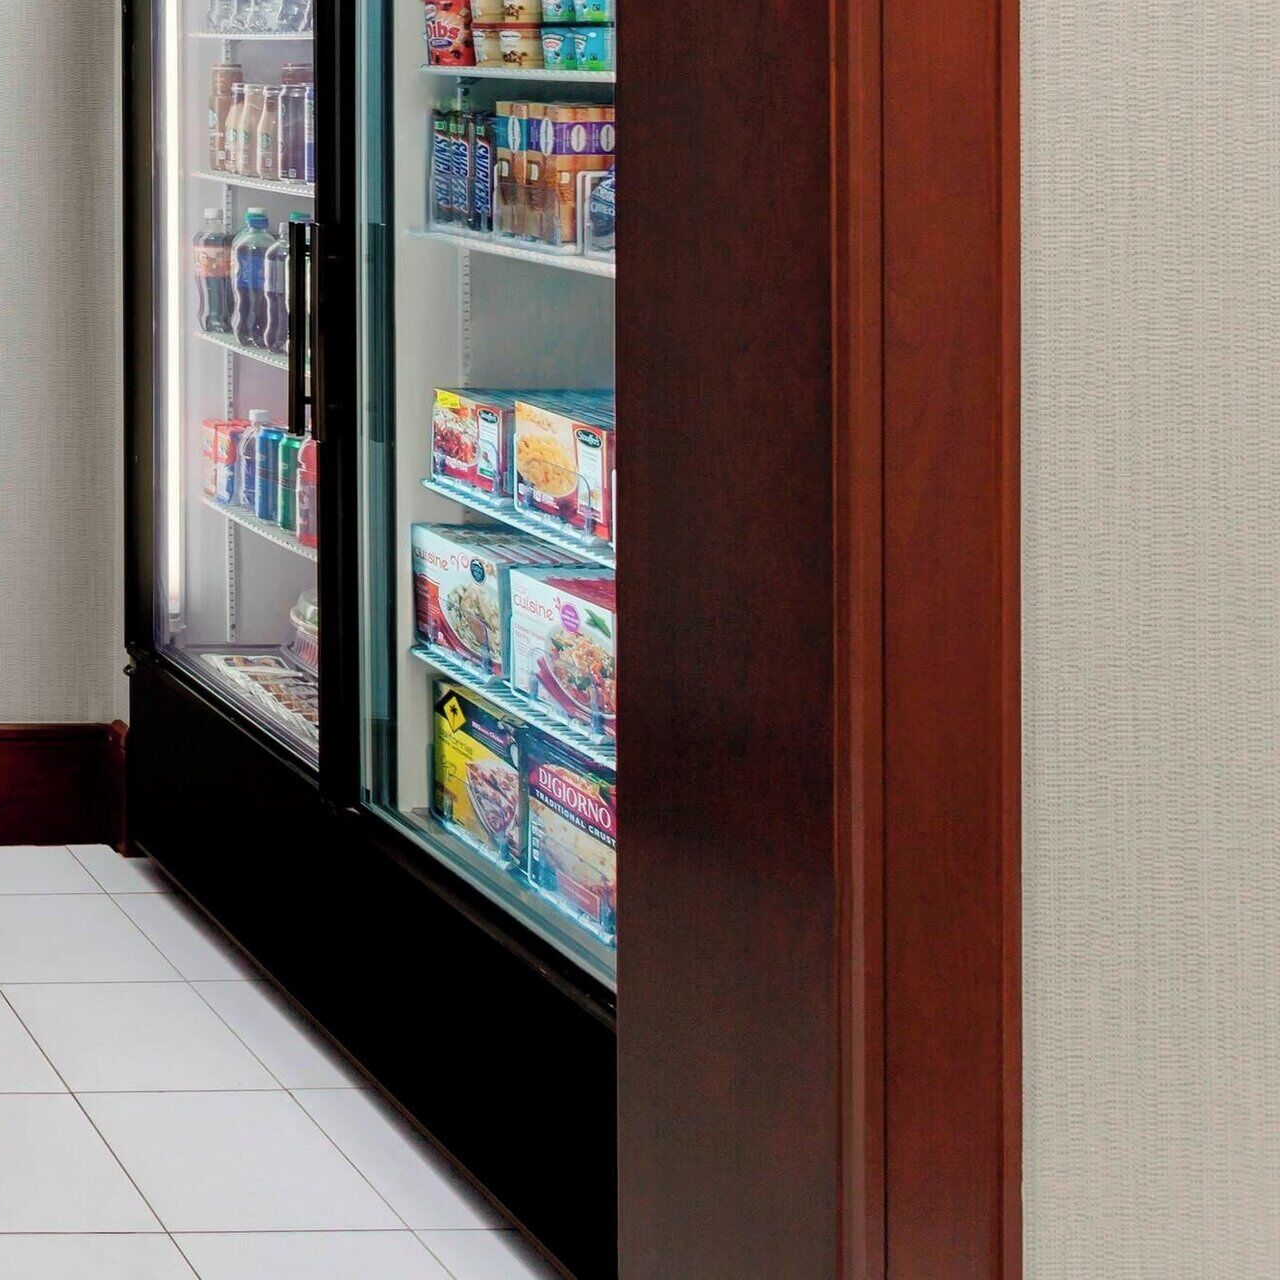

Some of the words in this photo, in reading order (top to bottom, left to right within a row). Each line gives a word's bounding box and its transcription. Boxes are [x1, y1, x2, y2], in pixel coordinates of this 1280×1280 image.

[514, 594, 554, 621] cuisine
[534, 788, 587, 829] TRADITIONAL
[588, 824, 617, 848] CRUST
[538, 766, 612, 829] DIGIORNO
